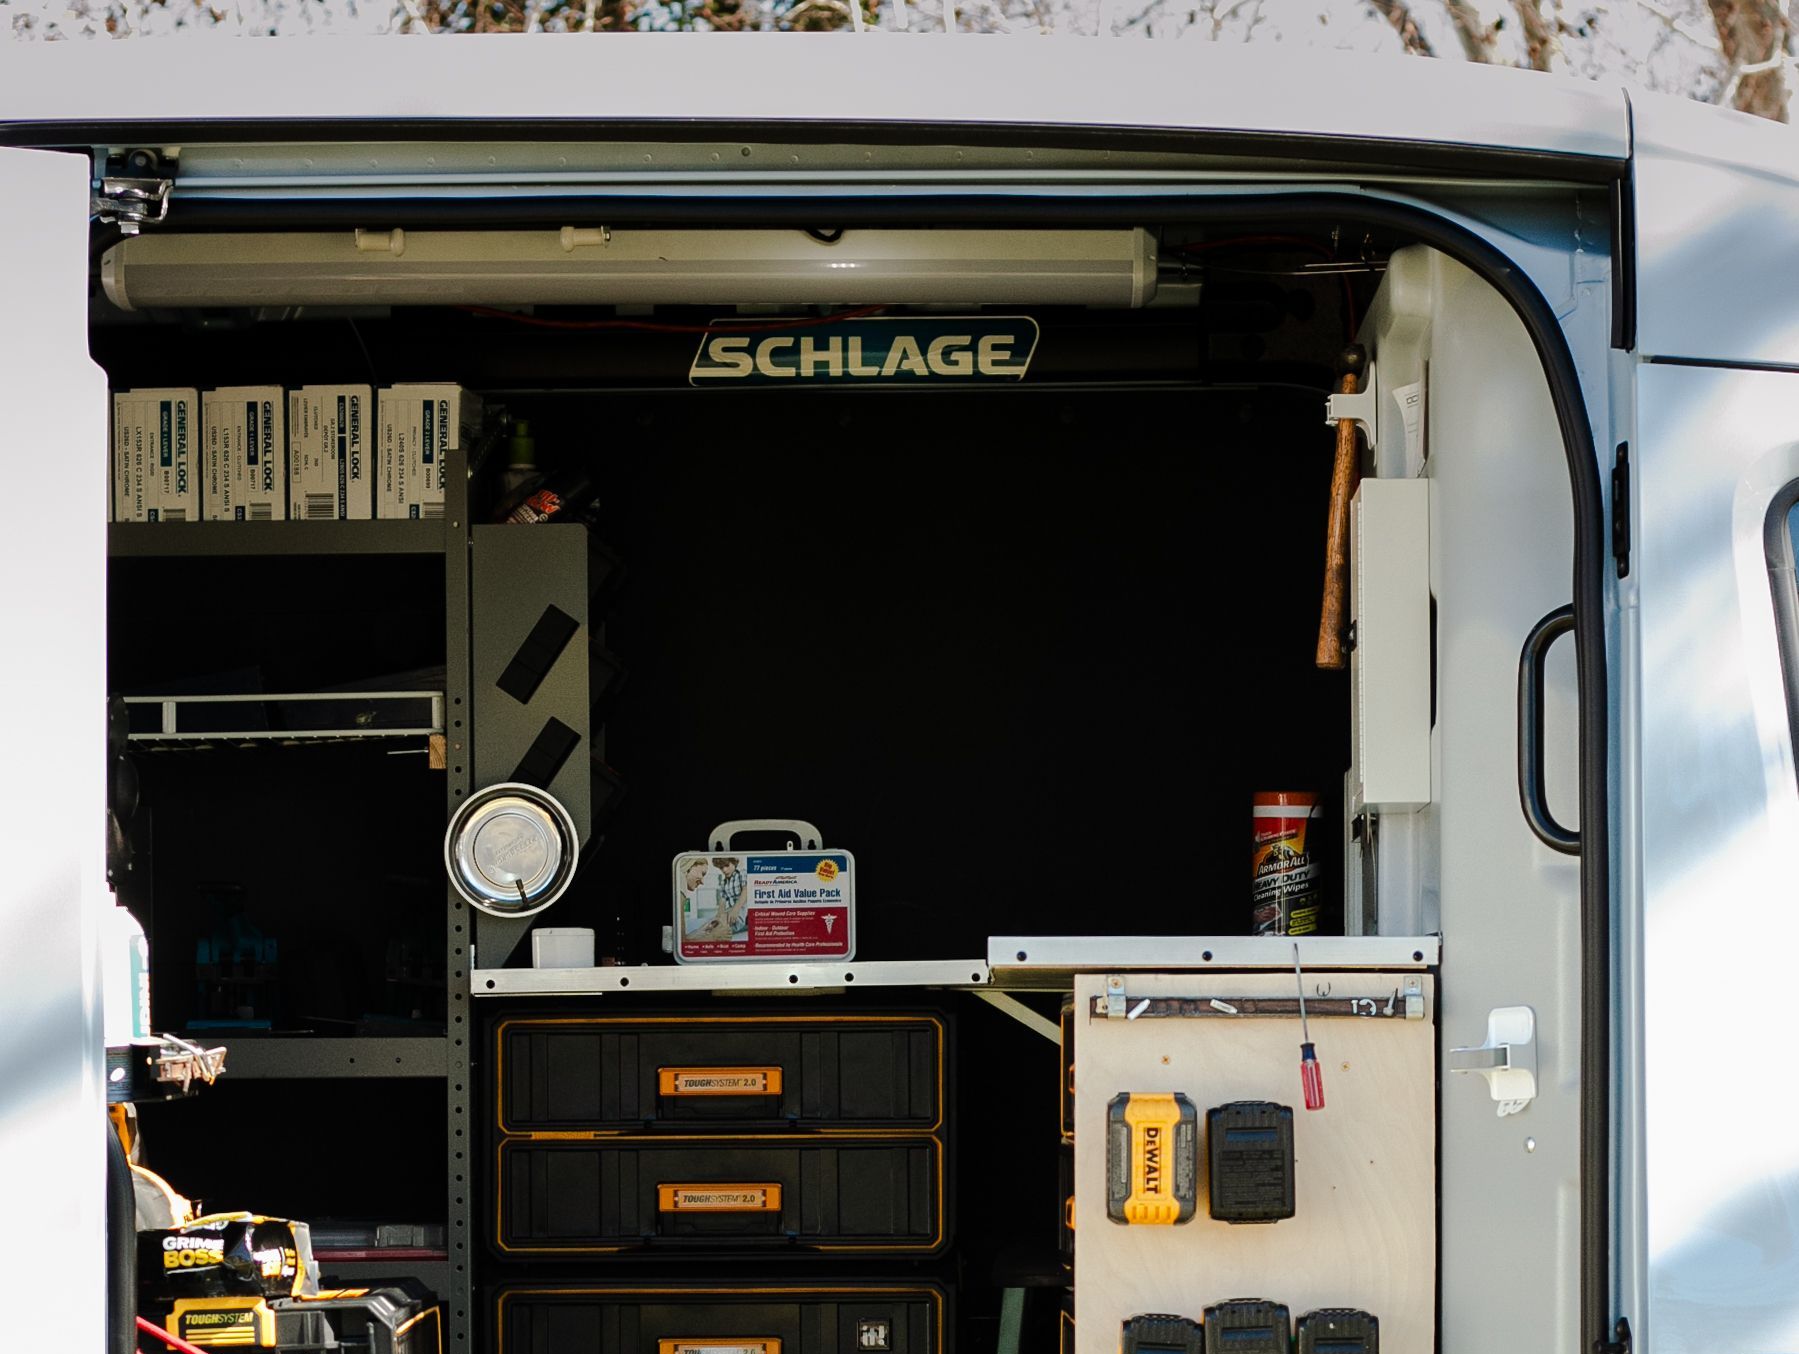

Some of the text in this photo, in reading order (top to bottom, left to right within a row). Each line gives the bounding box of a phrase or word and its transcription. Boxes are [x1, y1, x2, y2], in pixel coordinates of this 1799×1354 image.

[707, 334, 1017, 378] SCHLAGE
[263, 400, 273, 491] GENERAL LOCK
[350, 395, 360, 480] GENERAL LOCK
[439, 399, 448, 490] GENERAL LOCK
[177, 400, 187, 493] GENERAL LOCK
[135, 453, 143, 466] 626
[135, 474, 143, 486] 234
[135, 494, 143, 511] ANSI
[1282, 869, 1311, 884] DUTY
[754, 887, 841, 899] First Aid Value Pack
[1253, 880, 1310, 902] Cleaning Wipes
[684, 1078, 757, 1088] TOUGHSYSTEM 2.0
[682, 1194, 756, 1204] TOUGHSYSTEM 2.0
[163, 1249, 225, 1269] BOSS
[185, 1311, 255, 1325] TOUGHSYSTEM
